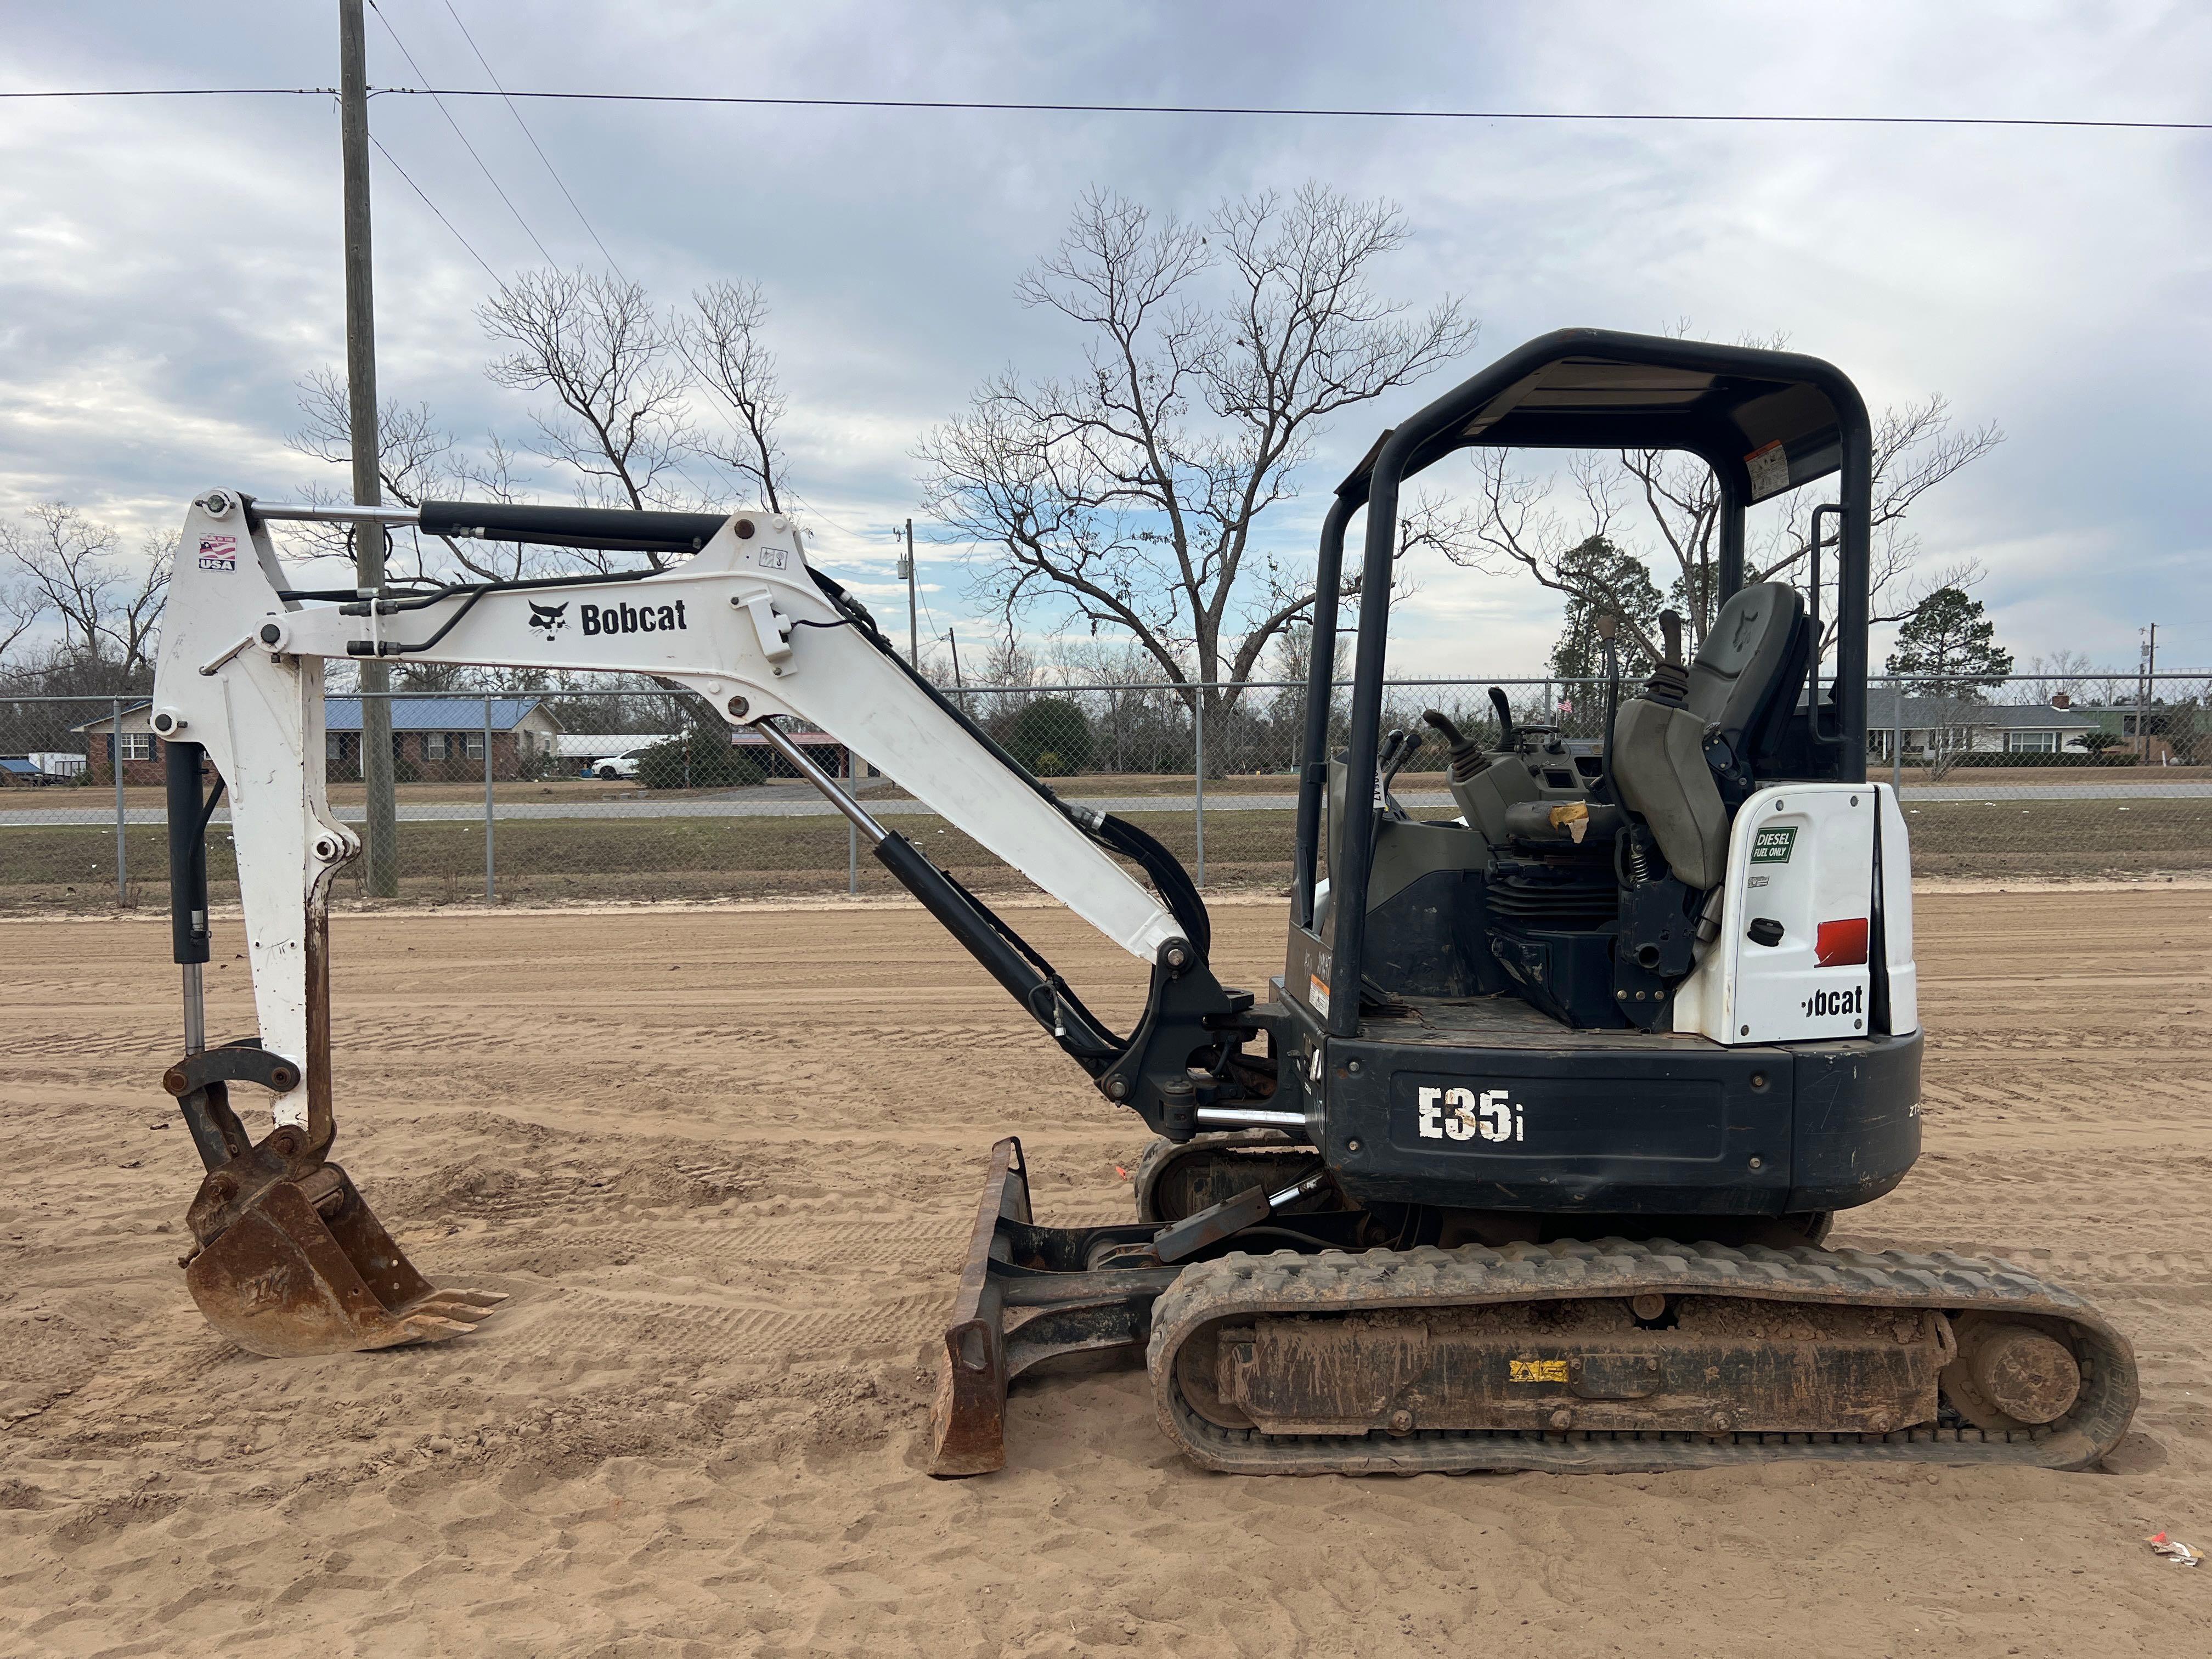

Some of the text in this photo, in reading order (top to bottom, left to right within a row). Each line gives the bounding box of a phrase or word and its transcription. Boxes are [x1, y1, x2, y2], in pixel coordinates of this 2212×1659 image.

[200, 559, 233, 570] USA
[580, 600, 687, 636] Bobcat
[1757, 833, 1790, 846] DIESEL
[1753, 847, 1787, 857] FUEL ONLY
[1801, 985, 1863, 1018] bcat
[1418, 1086, 1523, 1142] E35i
